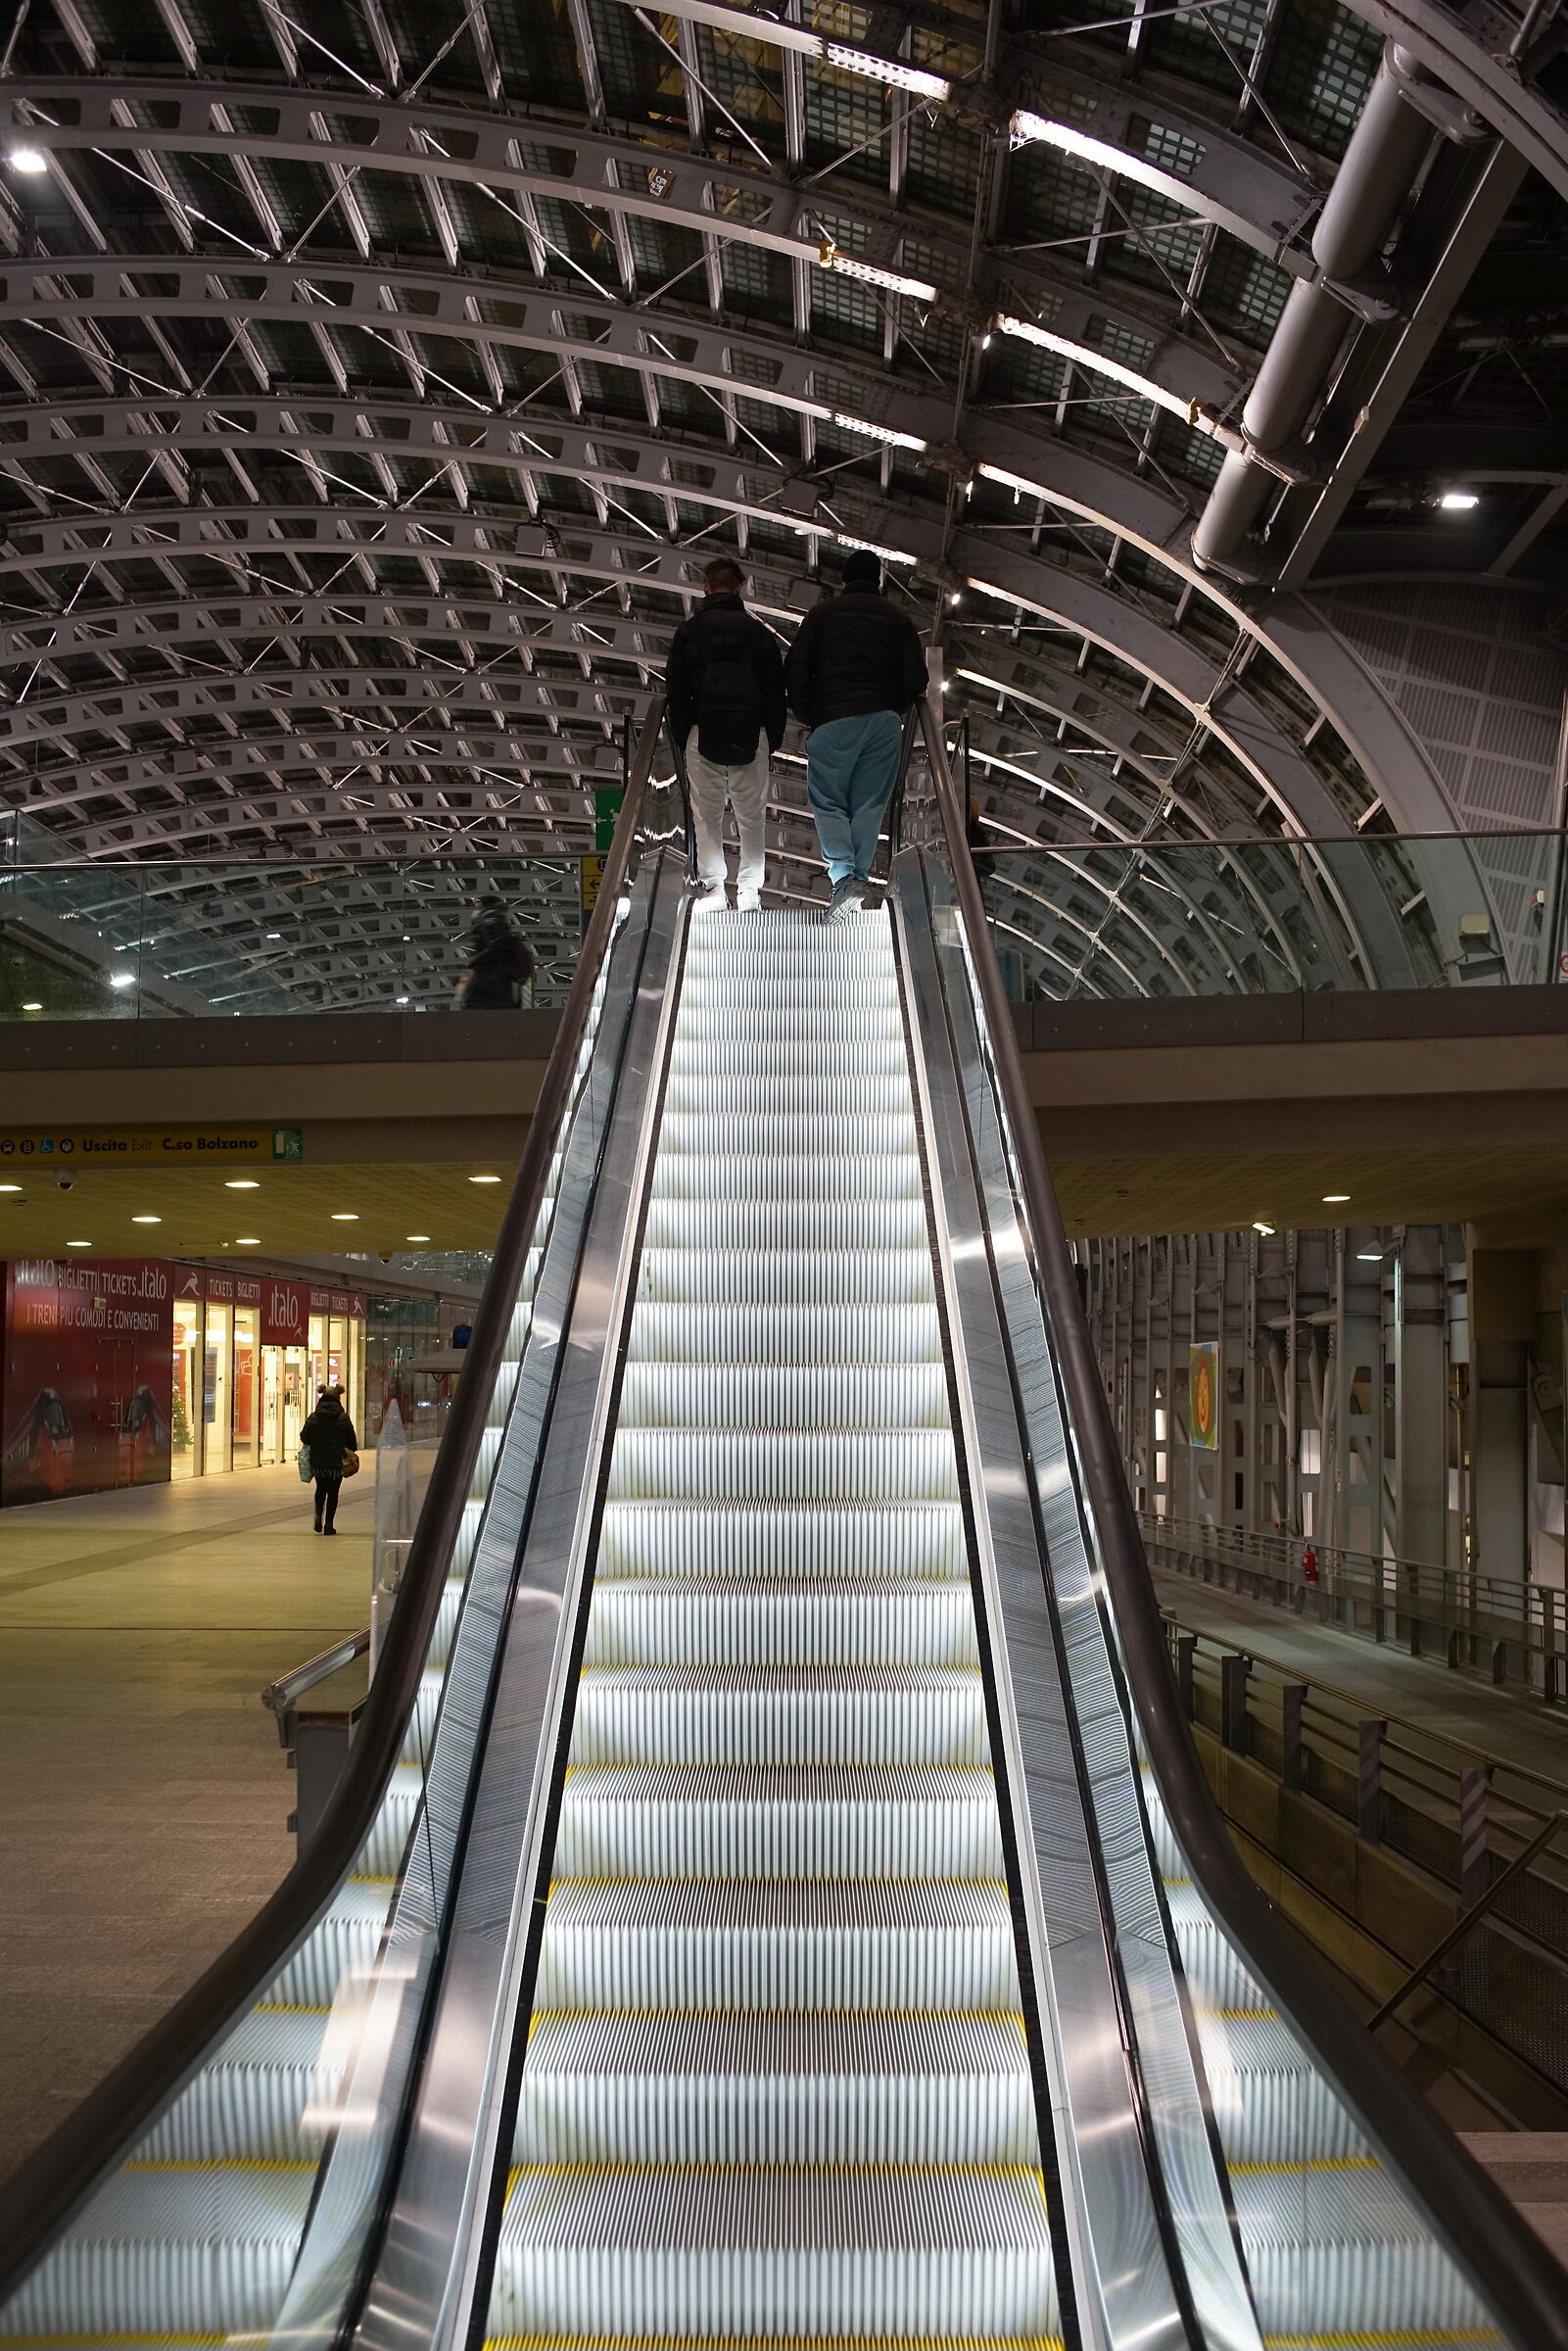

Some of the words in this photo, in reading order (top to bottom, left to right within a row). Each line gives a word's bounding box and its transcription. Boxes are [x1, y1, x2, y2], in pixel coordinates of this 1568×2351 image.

[82, 1139, 127, 1152] Uscita
[132, 1139, 152, 1152] Exit
[163, 1137, 192, 1151] C.so
[197, 1136, 259, 1151] Bolzano
[59, 1268, 97, 1291] BIGLIETTI
[102, 1272, 137, 1296] TICKETS
[209, 1278, 233, 1297] TICKETS
[237, 1281, 261, 1300] BIGLIETTI
[310, 1292, 330, 1307] BIGLIETTI
[332, 1296, 349, 1311] TICKETS
[33, 1304, 58, 1324] TRENI
[75, 1308, 106, 1327] COMODI
[108, 1311, 112, 1328] E
[115, 1310, 160, 1331] CONVENIENTI
